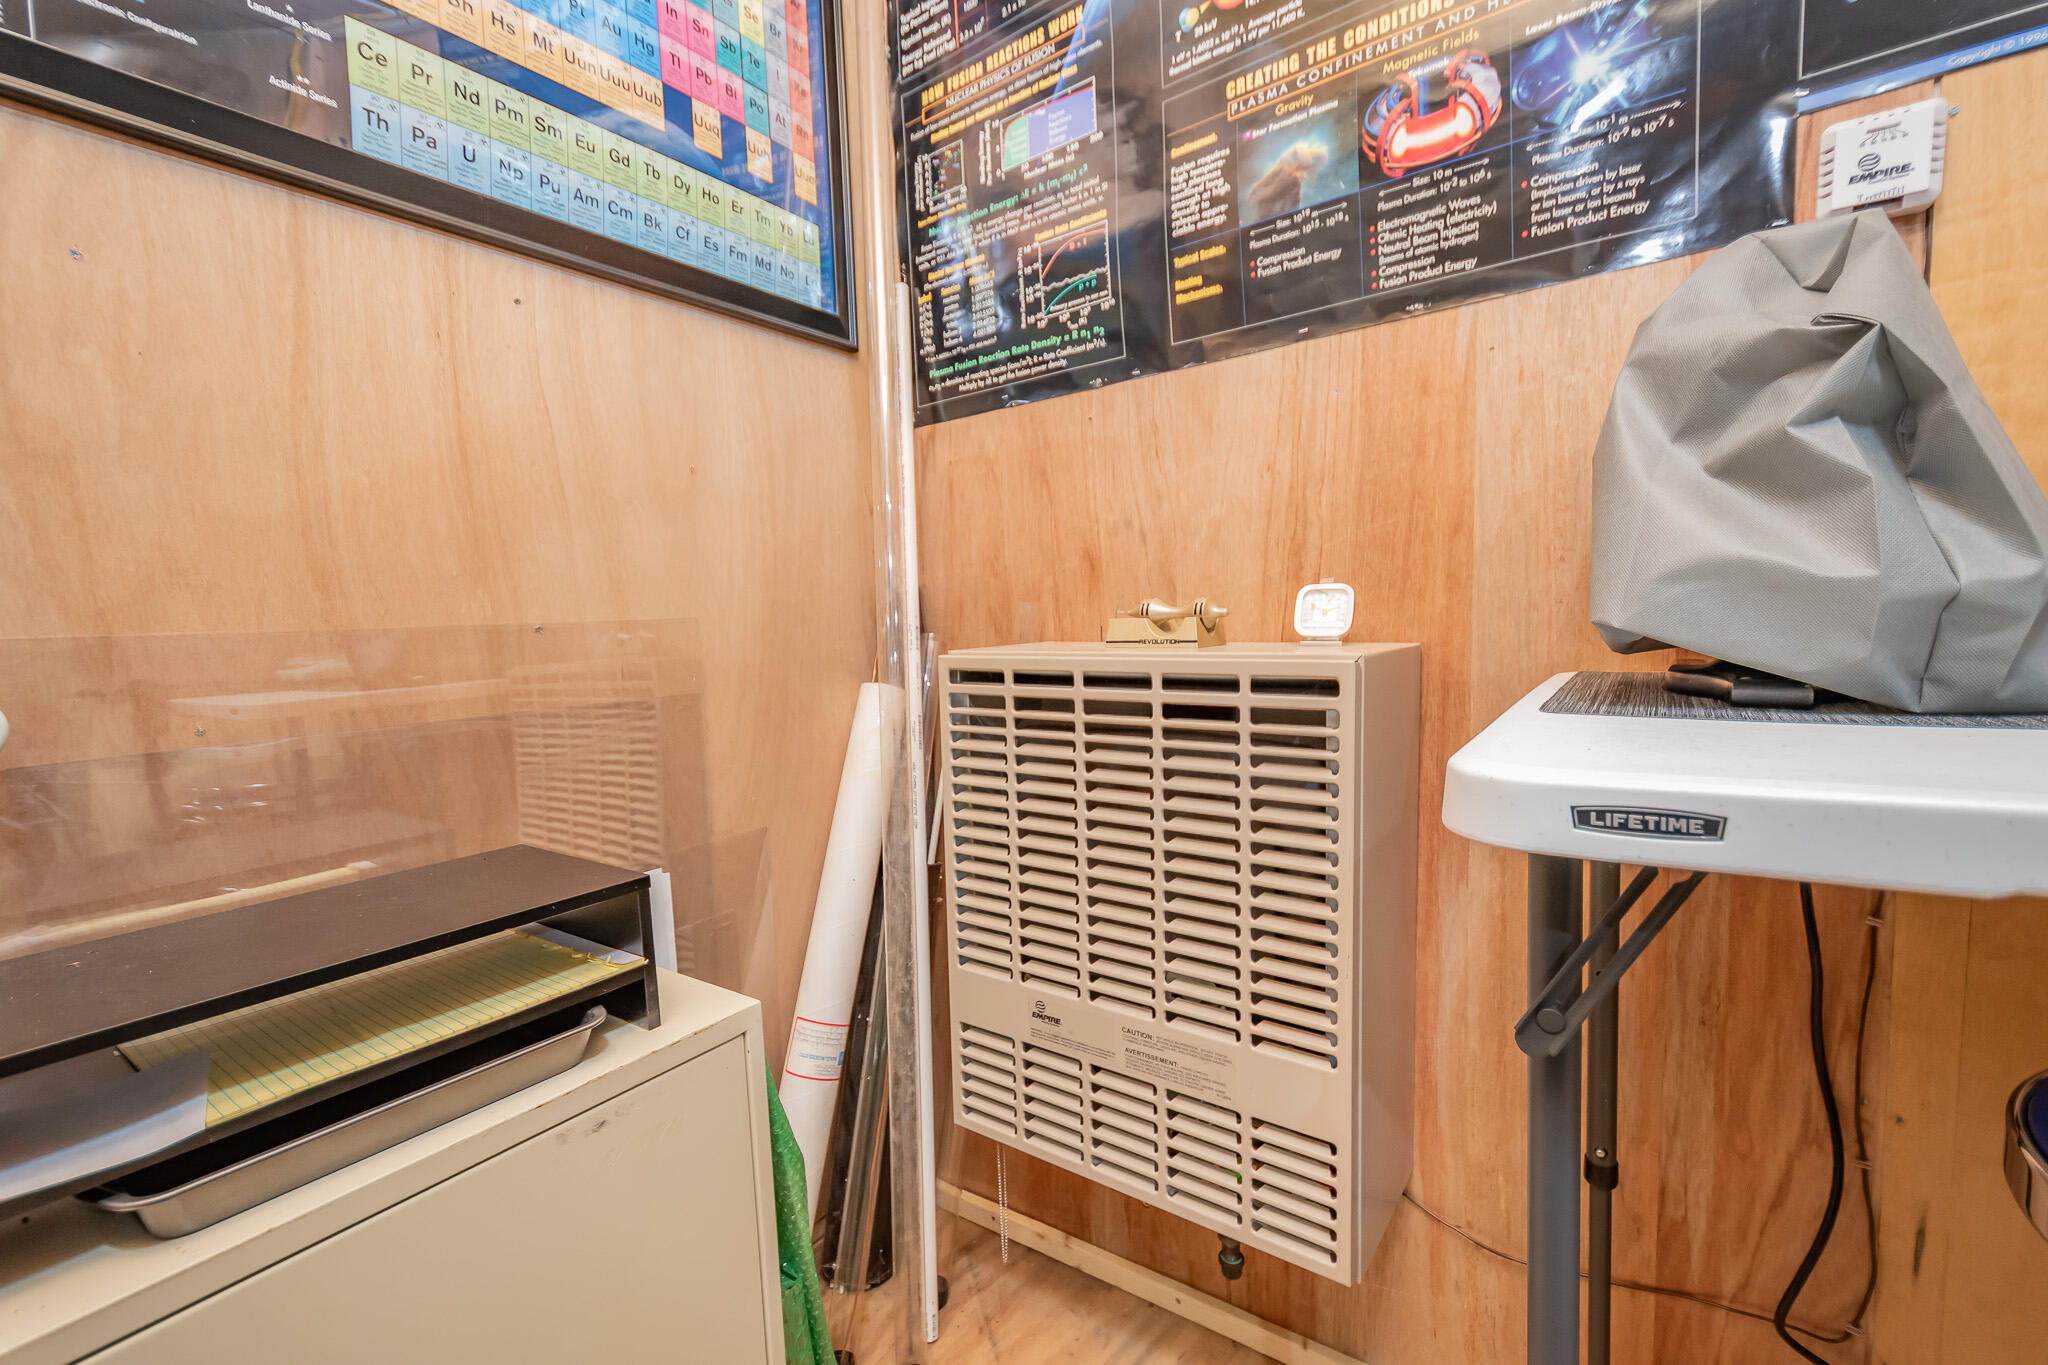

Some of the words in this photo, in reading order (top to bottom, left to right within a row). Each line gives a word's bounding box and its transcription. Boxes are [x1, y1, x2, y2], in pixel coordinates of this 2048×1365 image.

[692, 19, 709, 39] Sn
[720, 35, 737, 55] Sb
[491, 11, 516, 36] Hs
[633, 81, 662, 107] Uub
[921, 80, 946, 107] HOW
[947, 60, 984, 92] FUSION
[986, 25, 1046, 73] REACTIONS
[1023, 42, 1057, 68] FUSION
[1225, 53, 1300, 100] CREATING
[1305, 35, 1337, 65] THE
[1230, 82, 1289, 115] PLASMA
[1296, 25, 1425, 88] CONFINEMENT
[1434, 6, 1476, 33] AND
[1274, 93, 1315, 116] Gravity
[1383, 45, 1439, 75] Magnetic
[1442, 29, 1480, 52] Fields
[634, 33, 654, 57] Hg
[696, 67, 712, 86] Pb
[749, 97, 764, 115] Po
[357, 41, 388, 67] Ce
[411, 62, 433, 86] Pr
[454, 80, 480, 107] Nd
[495, 100, 524, 124] Pm
[534, 116, 562, 140] Sm
[576, 133, 596, 154] Eu
[609, 148, 630, 168] Gd
[642, 161, 661, 180] Tb
[674, 175, 691, 195] Dy
[702, 187, 720, 205] Ho
[731, 200, 744, 216] Er
[361, 107, 390, 133] Th
[413, 126, 438, 149] Pa
[462, 144, 476, 163] U
[499, 159, 524, 181] Np
[540, 173, 561, 195] Pu
[573, 188, 600, 209] Am
[608, 200, 634, 221] Cm
[644, 213, 663, 233] Bk
[704, 234, 720, 252] Es
[730, 244, 748, 262] Fm
[754, 255, 772, 272] Md
[1530, 161, 1600, 188] Compression
[1575, 173, 1604, 188] driven
[1605, 169, 1618, 182] by
[1618, 163, 1642, 175] laser
[1602, 182, 1616, 195] by
[1624, 174, 1646, 188] rays
[1848, 162, 1915, 186] EMPIRE
[1448, 194, 1482, 211] Waves
[1530, 211, 1551, 224] from
[1552, 204, 1573, 217] laser
[1602, 187, 1637, 205] beams)
[1531, 220, 1564, 238] Fusion
[1566, 209, 1609, 229] Product
[1609, 199, 1650, 219] Energy
[1378, 228, 1408, 244] Ohmic
[1408, 217, 1446, 235] Heating
[1378, 236, 1412, 255] Neutral
[1412, 231, 1439, 248] Beam
[1439, 220, 1480, 240] Injection
[1256, 246, 1306, 268] Compression
[1257, 264, 1282, 279] Fusion
[1282, 254, 1313, 272] Product
[1313, 247, 1343, 263] Energy
[1379, 255, 1437, 277] Compression
[1379, 274, 1408, 290] Fusion
[1408, 263, 1444, 282] Product
[1444, 255, 1479, 273] Energy
[929, 365, 955, 379] Plasma
[954, 358, 979, 375] Fusion
[978, 349, 1011, 364] Reaction
[1011, 343, 1031, 356] Rate
[1030, 334, 1063, 351] Density
[1138, 638, 1181, 646] REVOLUTION
[1590, 811, 1705, 834] LIFETIME
[1032, 1010, 1062, 1026] EMPIRE
